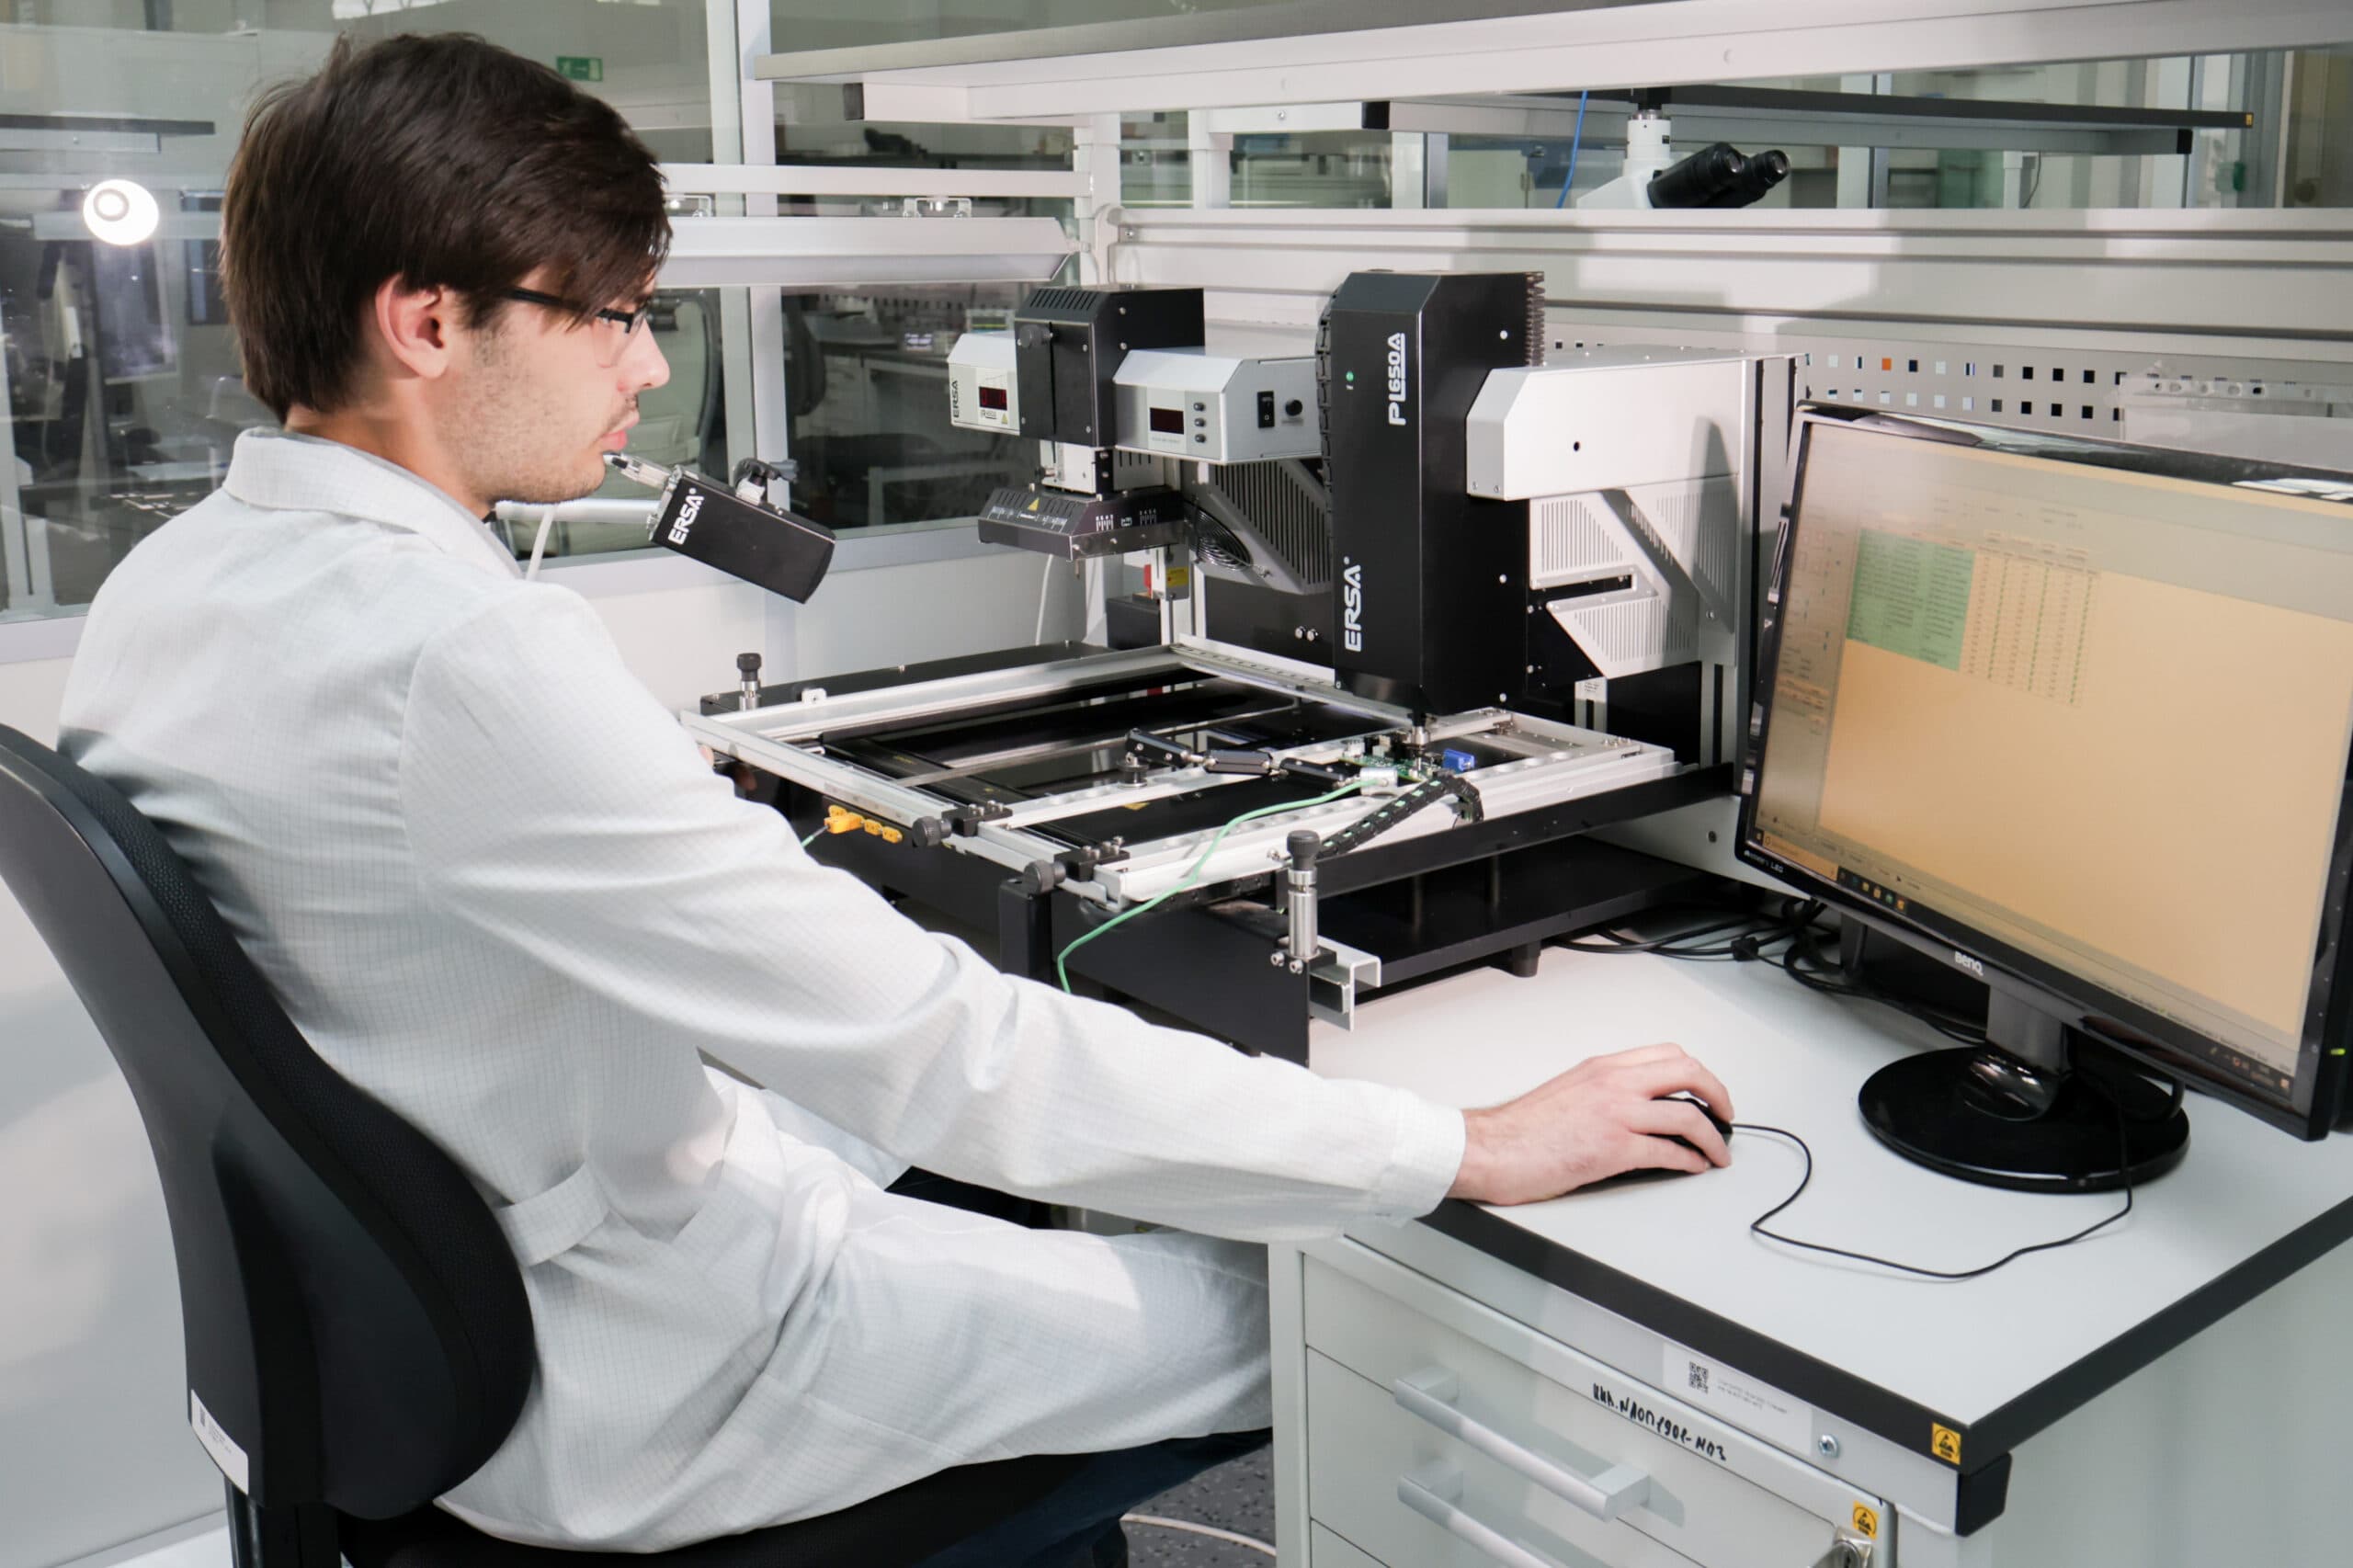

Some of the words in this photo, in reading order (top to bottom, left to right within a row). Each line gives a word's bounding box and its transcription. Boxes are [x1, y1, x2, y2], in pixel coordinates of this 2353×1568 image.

[950, 380, 960, 418] ERSA
[1387, 332, 1406, 426] PL650A
[667, 493, 705, 546] ERSA
[1343, 563, 1362, 653] ERSA
